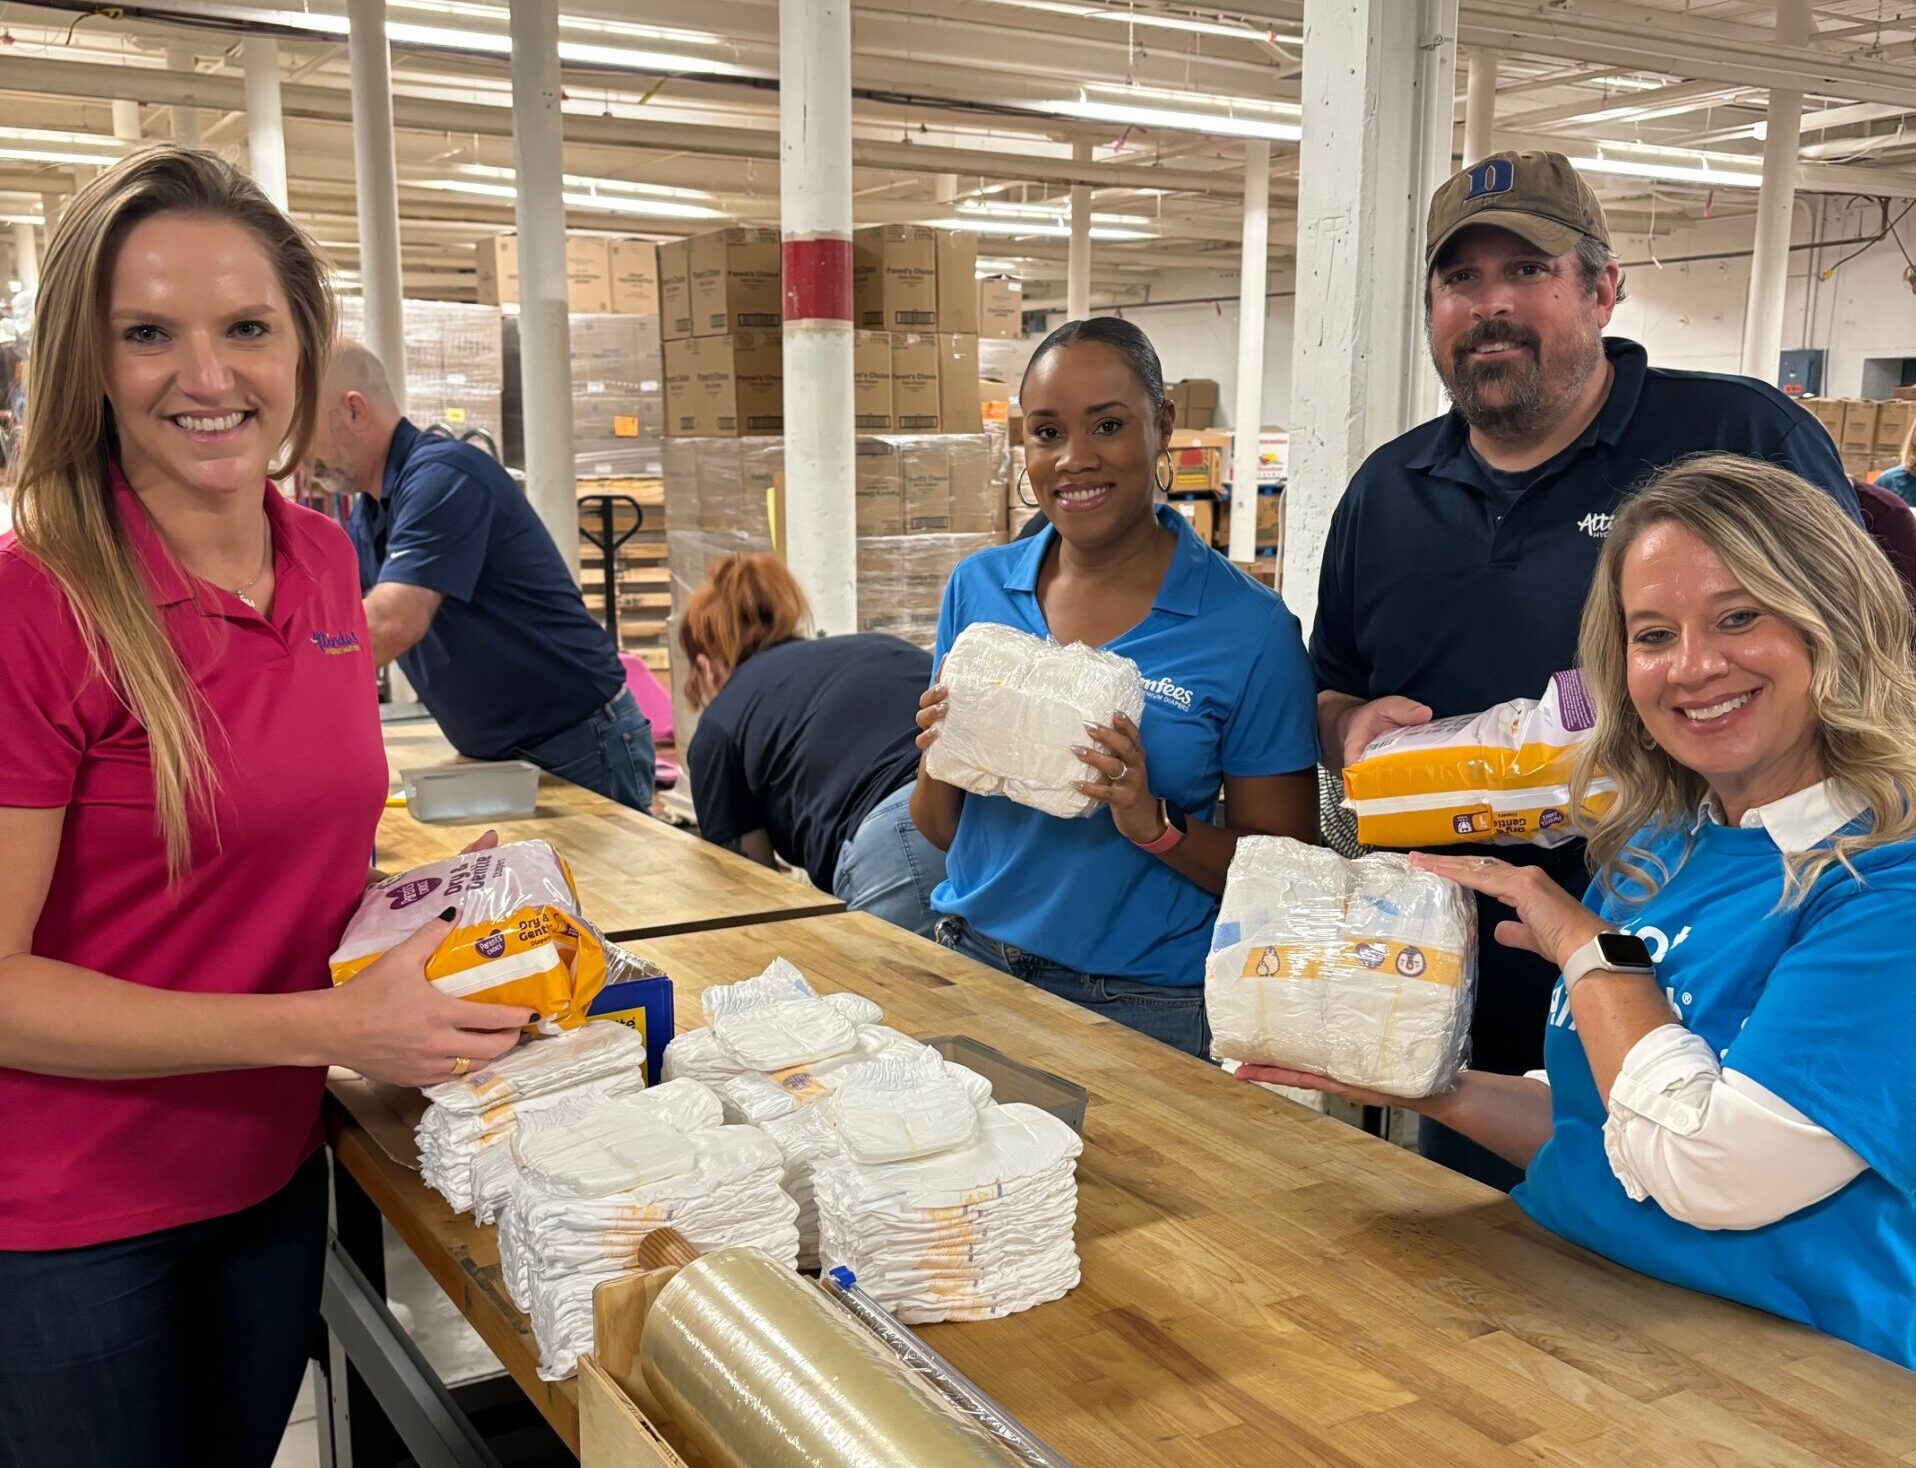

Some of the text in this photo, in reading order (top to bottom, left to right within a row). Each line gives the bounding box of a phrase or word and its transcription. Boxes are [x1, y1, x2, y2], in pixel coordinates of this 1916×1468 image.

[1463, 159, 1514, 203] D
[1140, 677, 1193, 704] mfees
[443, 870, 472, 896] Dry
[519, 917, 540, 931] Dry
